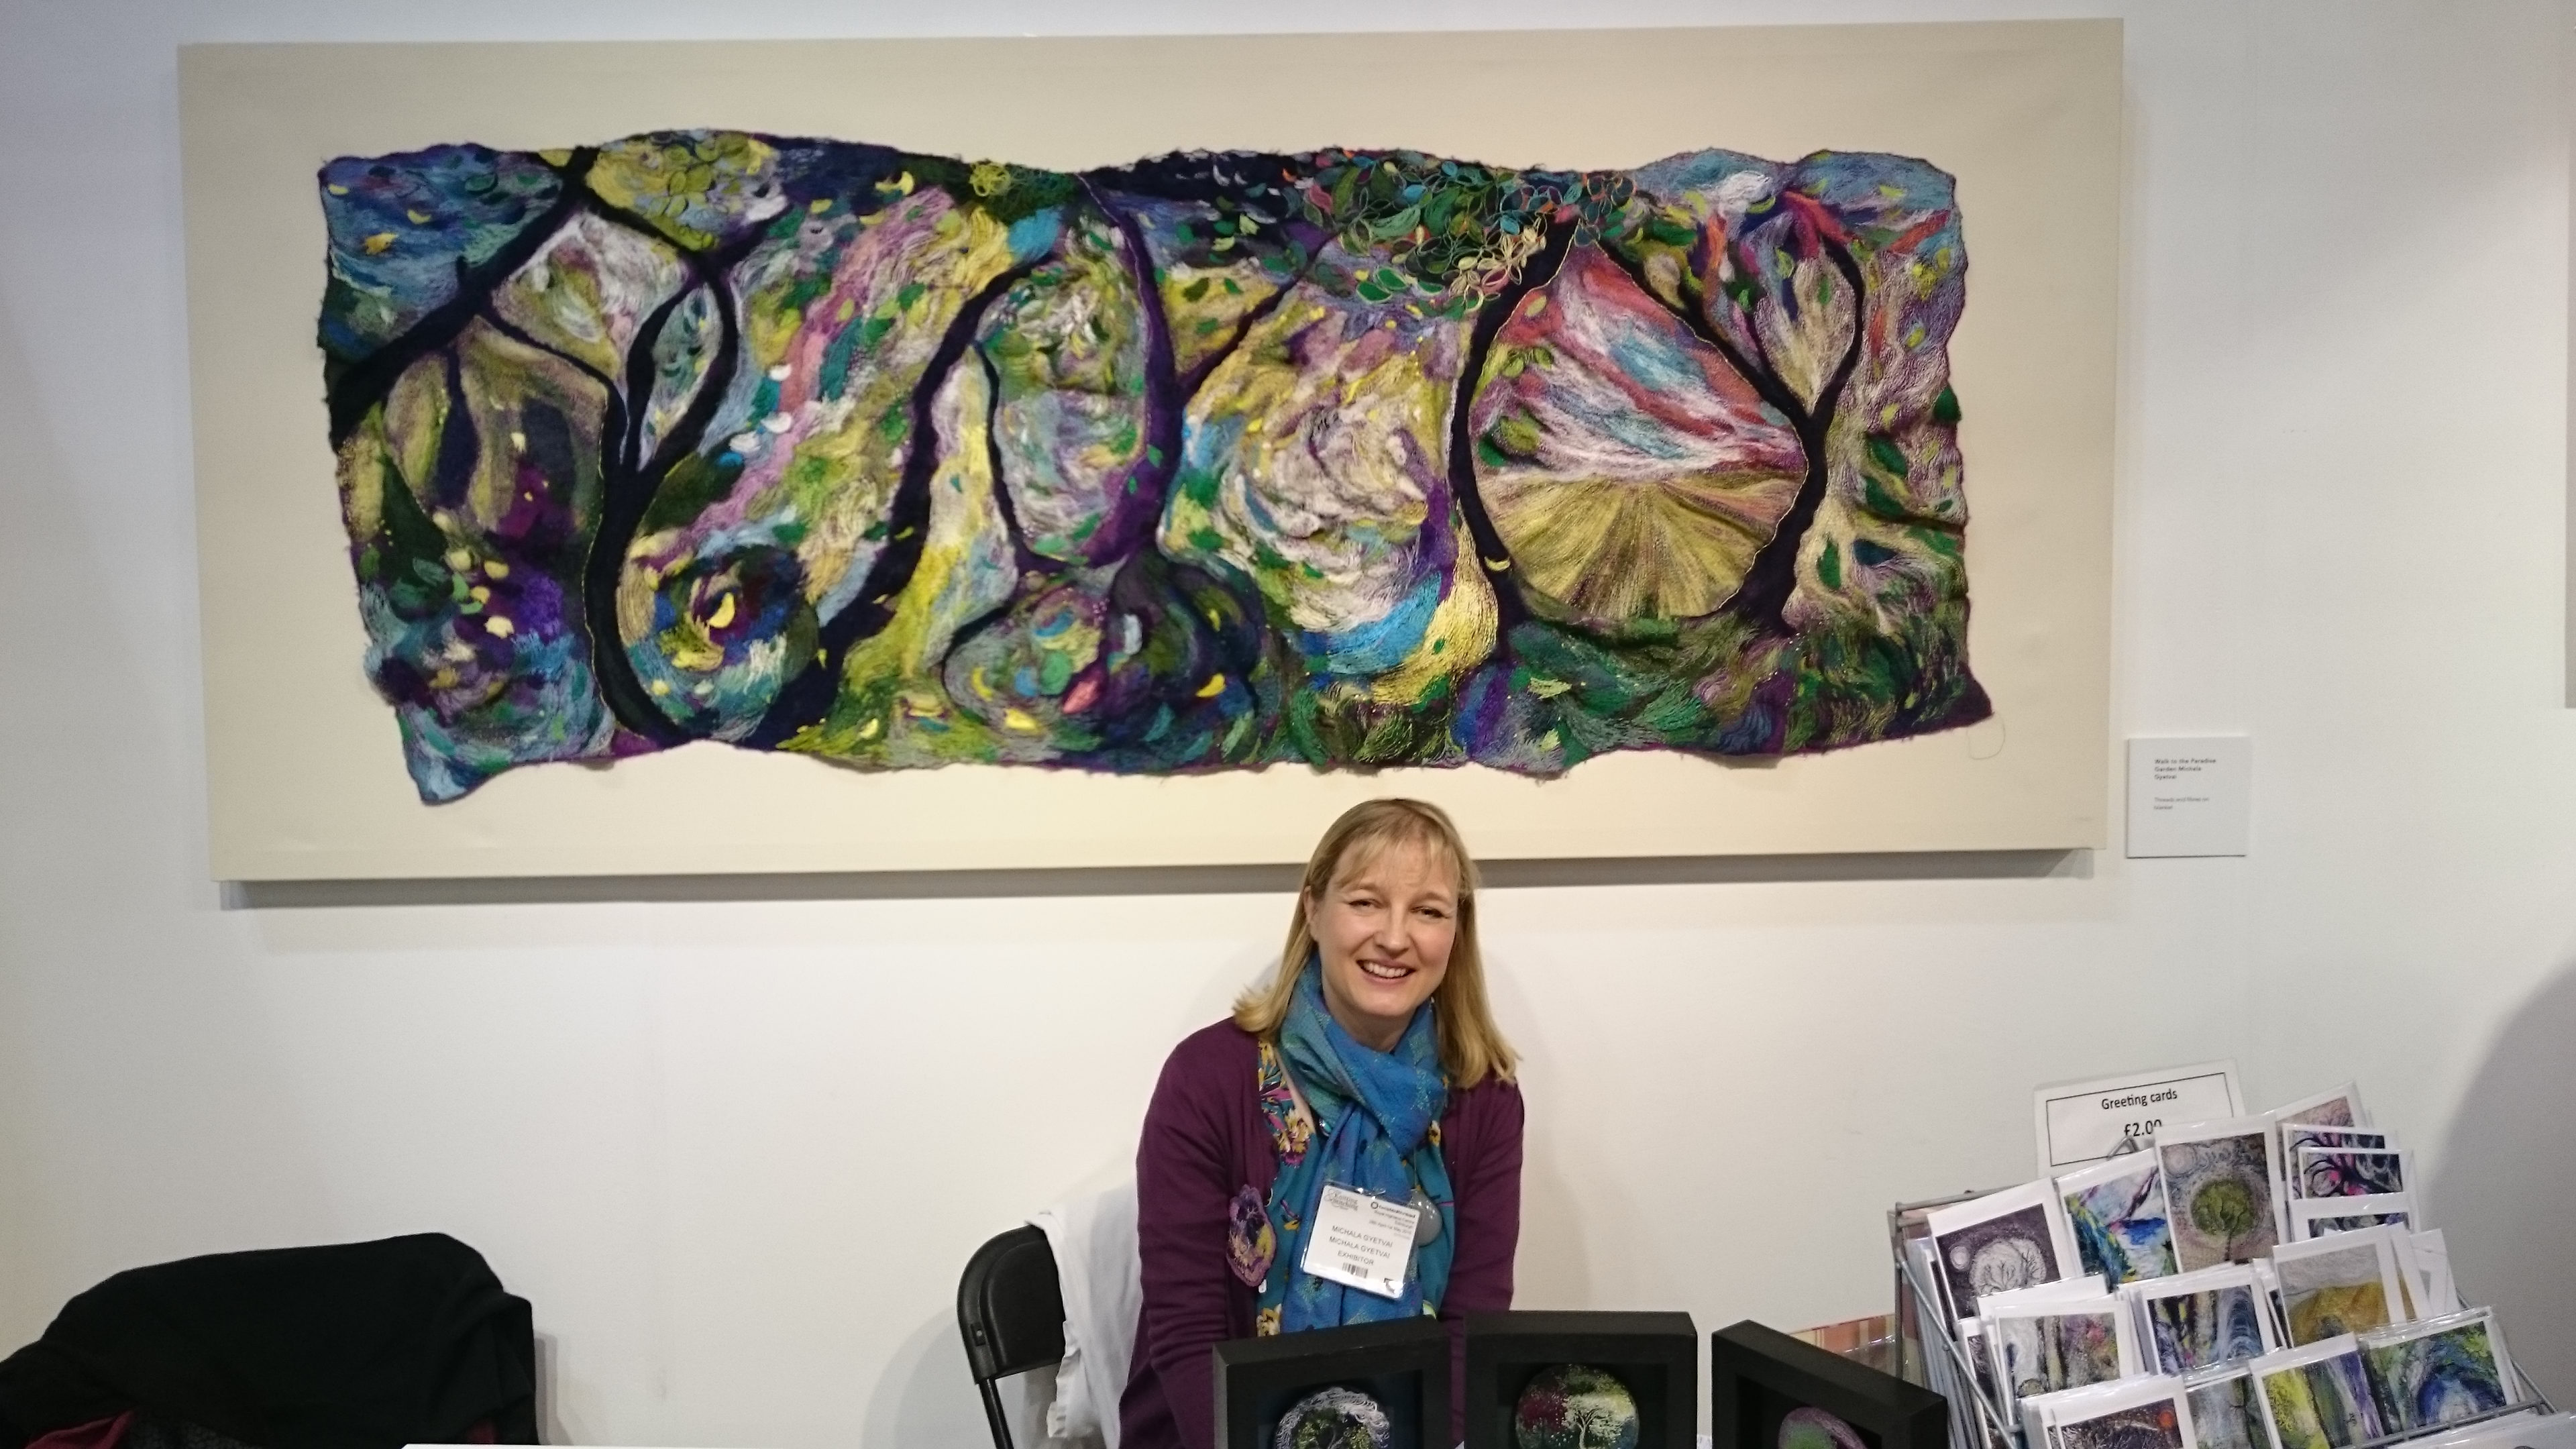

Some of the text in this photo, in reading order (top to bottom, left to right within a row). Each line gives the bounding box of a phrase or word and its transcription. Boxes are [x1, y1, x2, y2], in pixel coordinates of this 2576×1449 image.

[2101, 1088, 2178, 1110] Greeting cards
[1328, 1236, 1390, 1258] MICHALA GYETVAI
[1332, 1225, 1362, 1238] MICHALA
[1362, 1234, 1393, 1247] GYETVAI
[1337, 1250, 1374, 1265] EXHIBITOR
